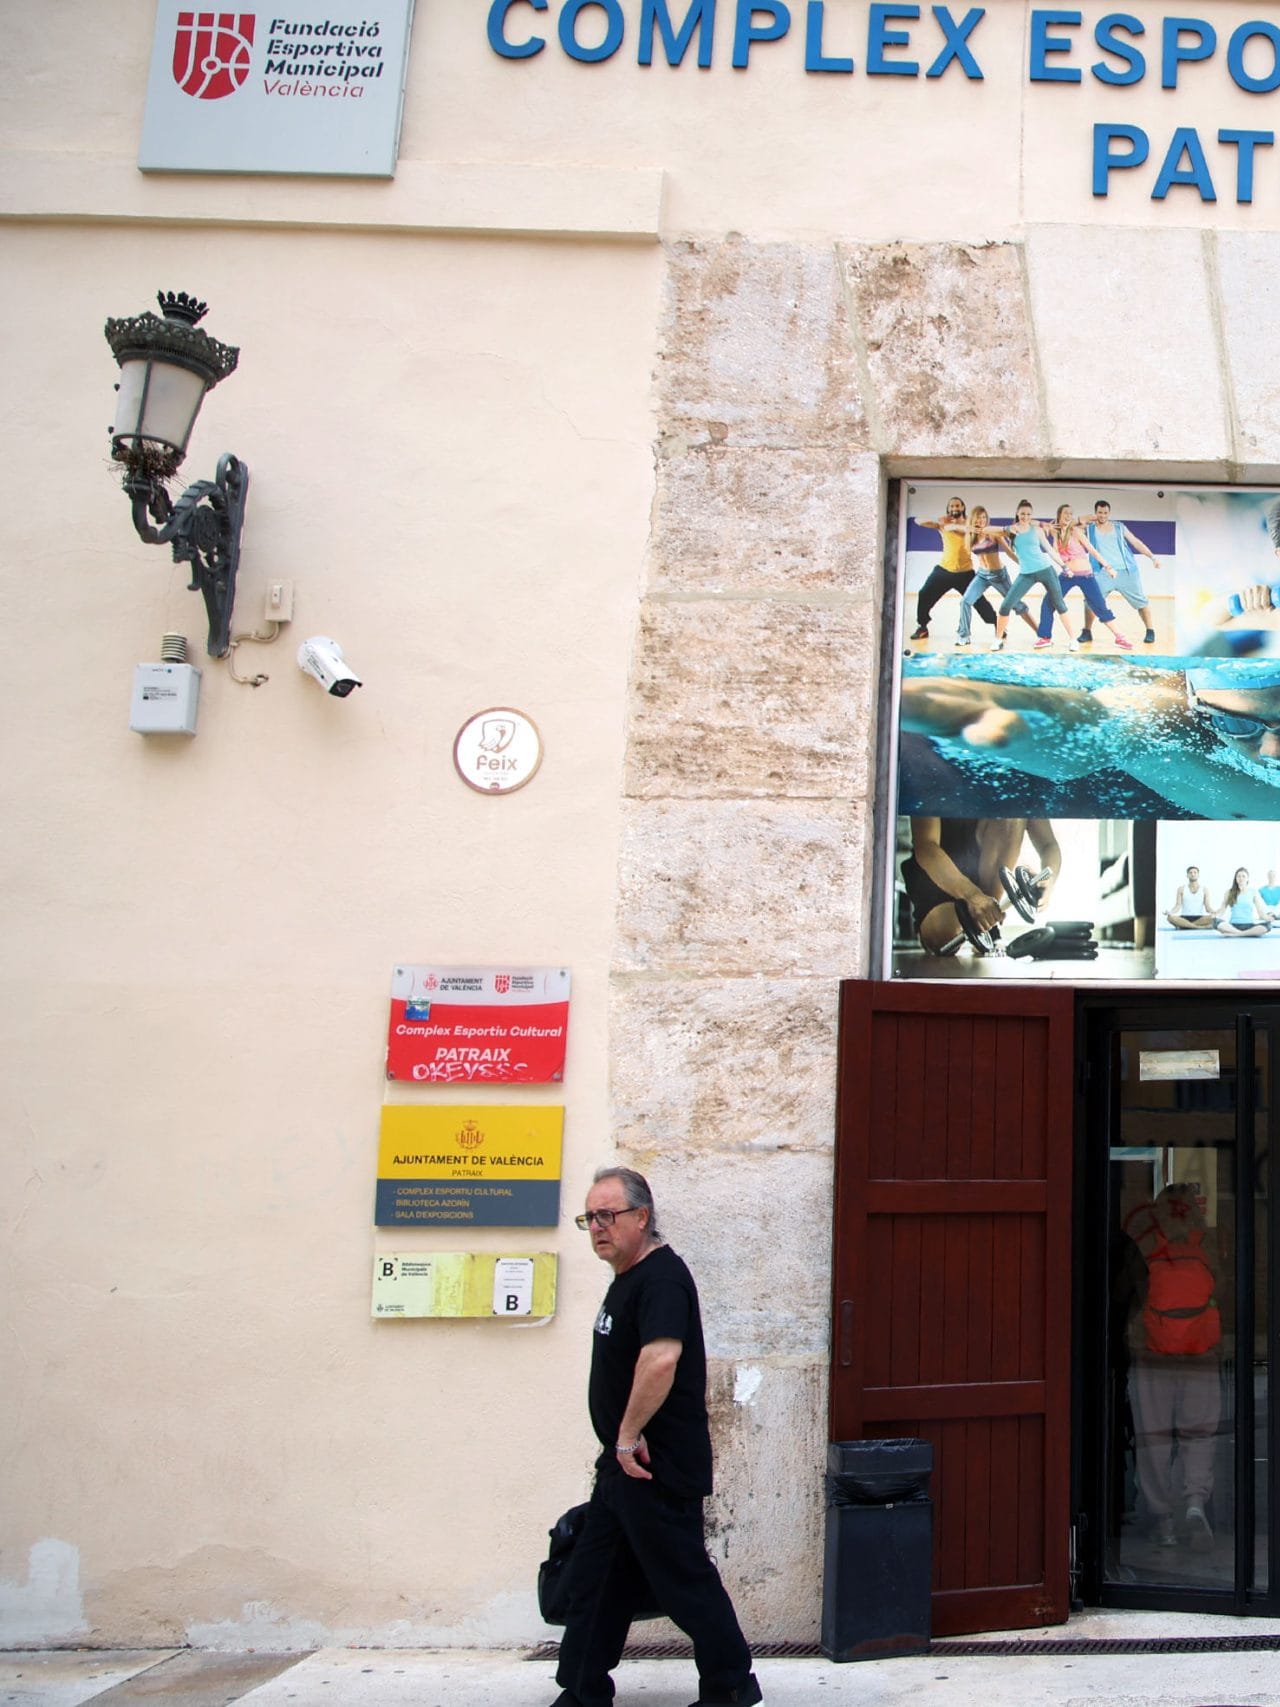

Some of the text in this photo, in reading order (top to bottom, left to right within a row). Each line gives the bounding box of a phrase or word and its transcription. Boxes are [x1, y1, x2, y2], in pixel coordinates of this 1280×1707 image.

[268, 19, 380, 37] Fundació
[487, 0, 985, 79] COMPLEX
[266, 40, 383, 59] Esportiva
[264, 60, 384, 81] Municipal
[263, 80, 364, 98] València
[440, 977, 483, 985] AJUNTAMENT
[396, 1024, 563, 1039] Complex Esportiu Cultural
[435, 1048, 512, 1062] PATRAIX
[393, 1154, 544, 1166] AJUNTAMENT DE VALÈNCIA
[452, 1169, 483, 1177] PATRAIX
[396, 1188, 513, 1197] COMPLEX ESPORTIU CULTURAL
[383, 1262, 394, 1276] B
[506, 1294, 519, 1311] B
